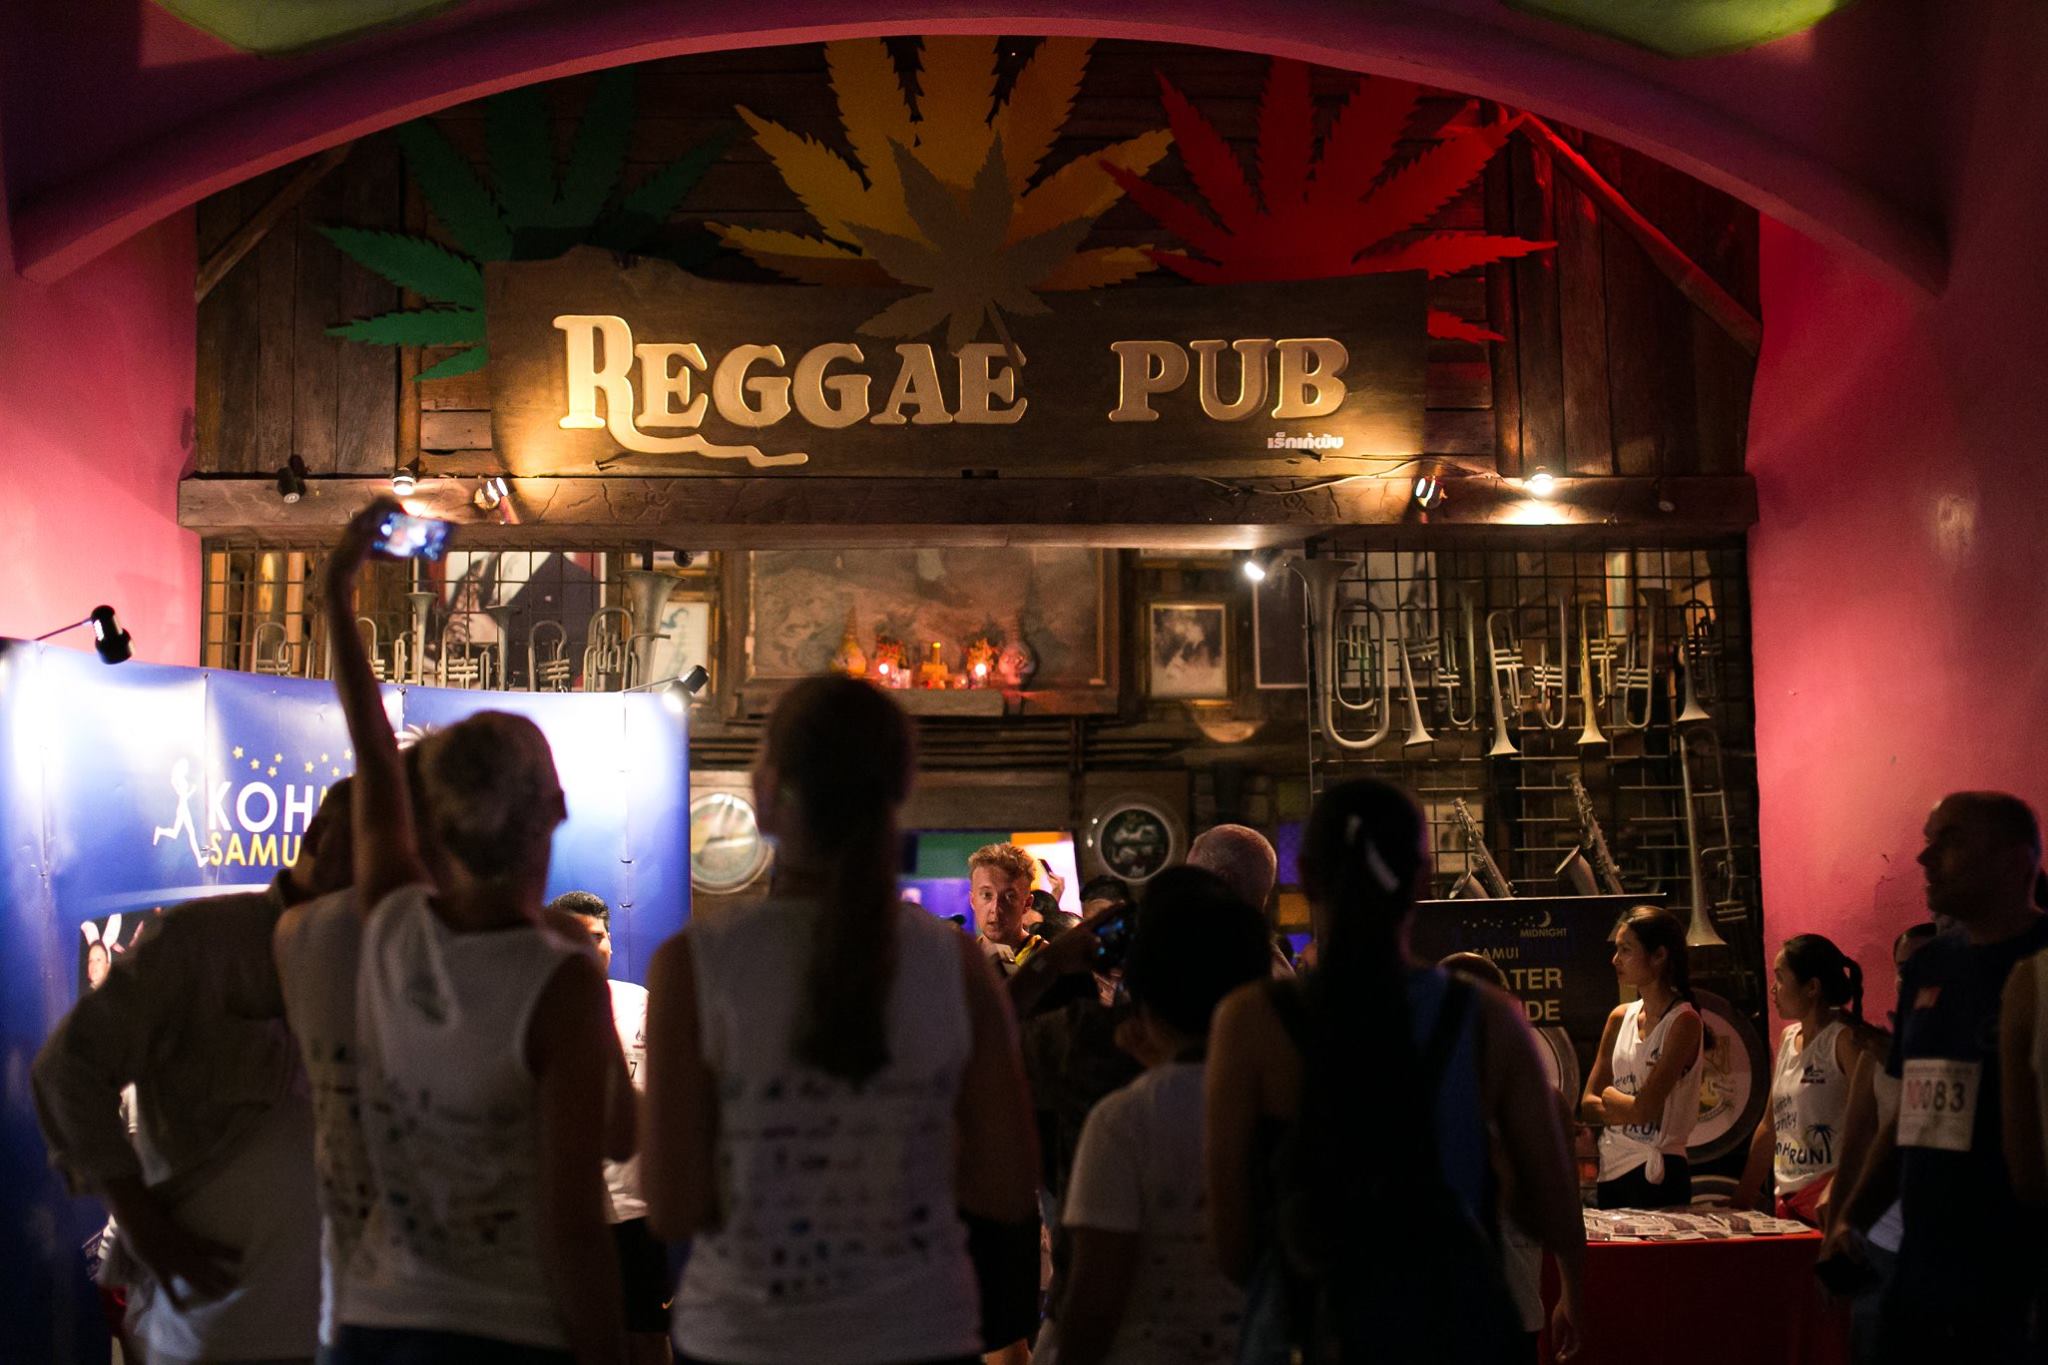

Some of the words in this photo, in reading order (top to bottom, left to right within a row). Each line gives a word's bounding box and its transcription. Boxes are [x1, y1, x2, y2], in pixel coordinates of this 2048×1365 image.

[553, 314, 1028, 467] REGGAE
[1108, 338, 1349, 422] PUB
[208, 781, 314, 832] KOH
[209, 831, 302, 868] SAMU
[1520, 927, 1568, 938] MIDNIGHT
[1525, 999, 1561, 1022] DE
